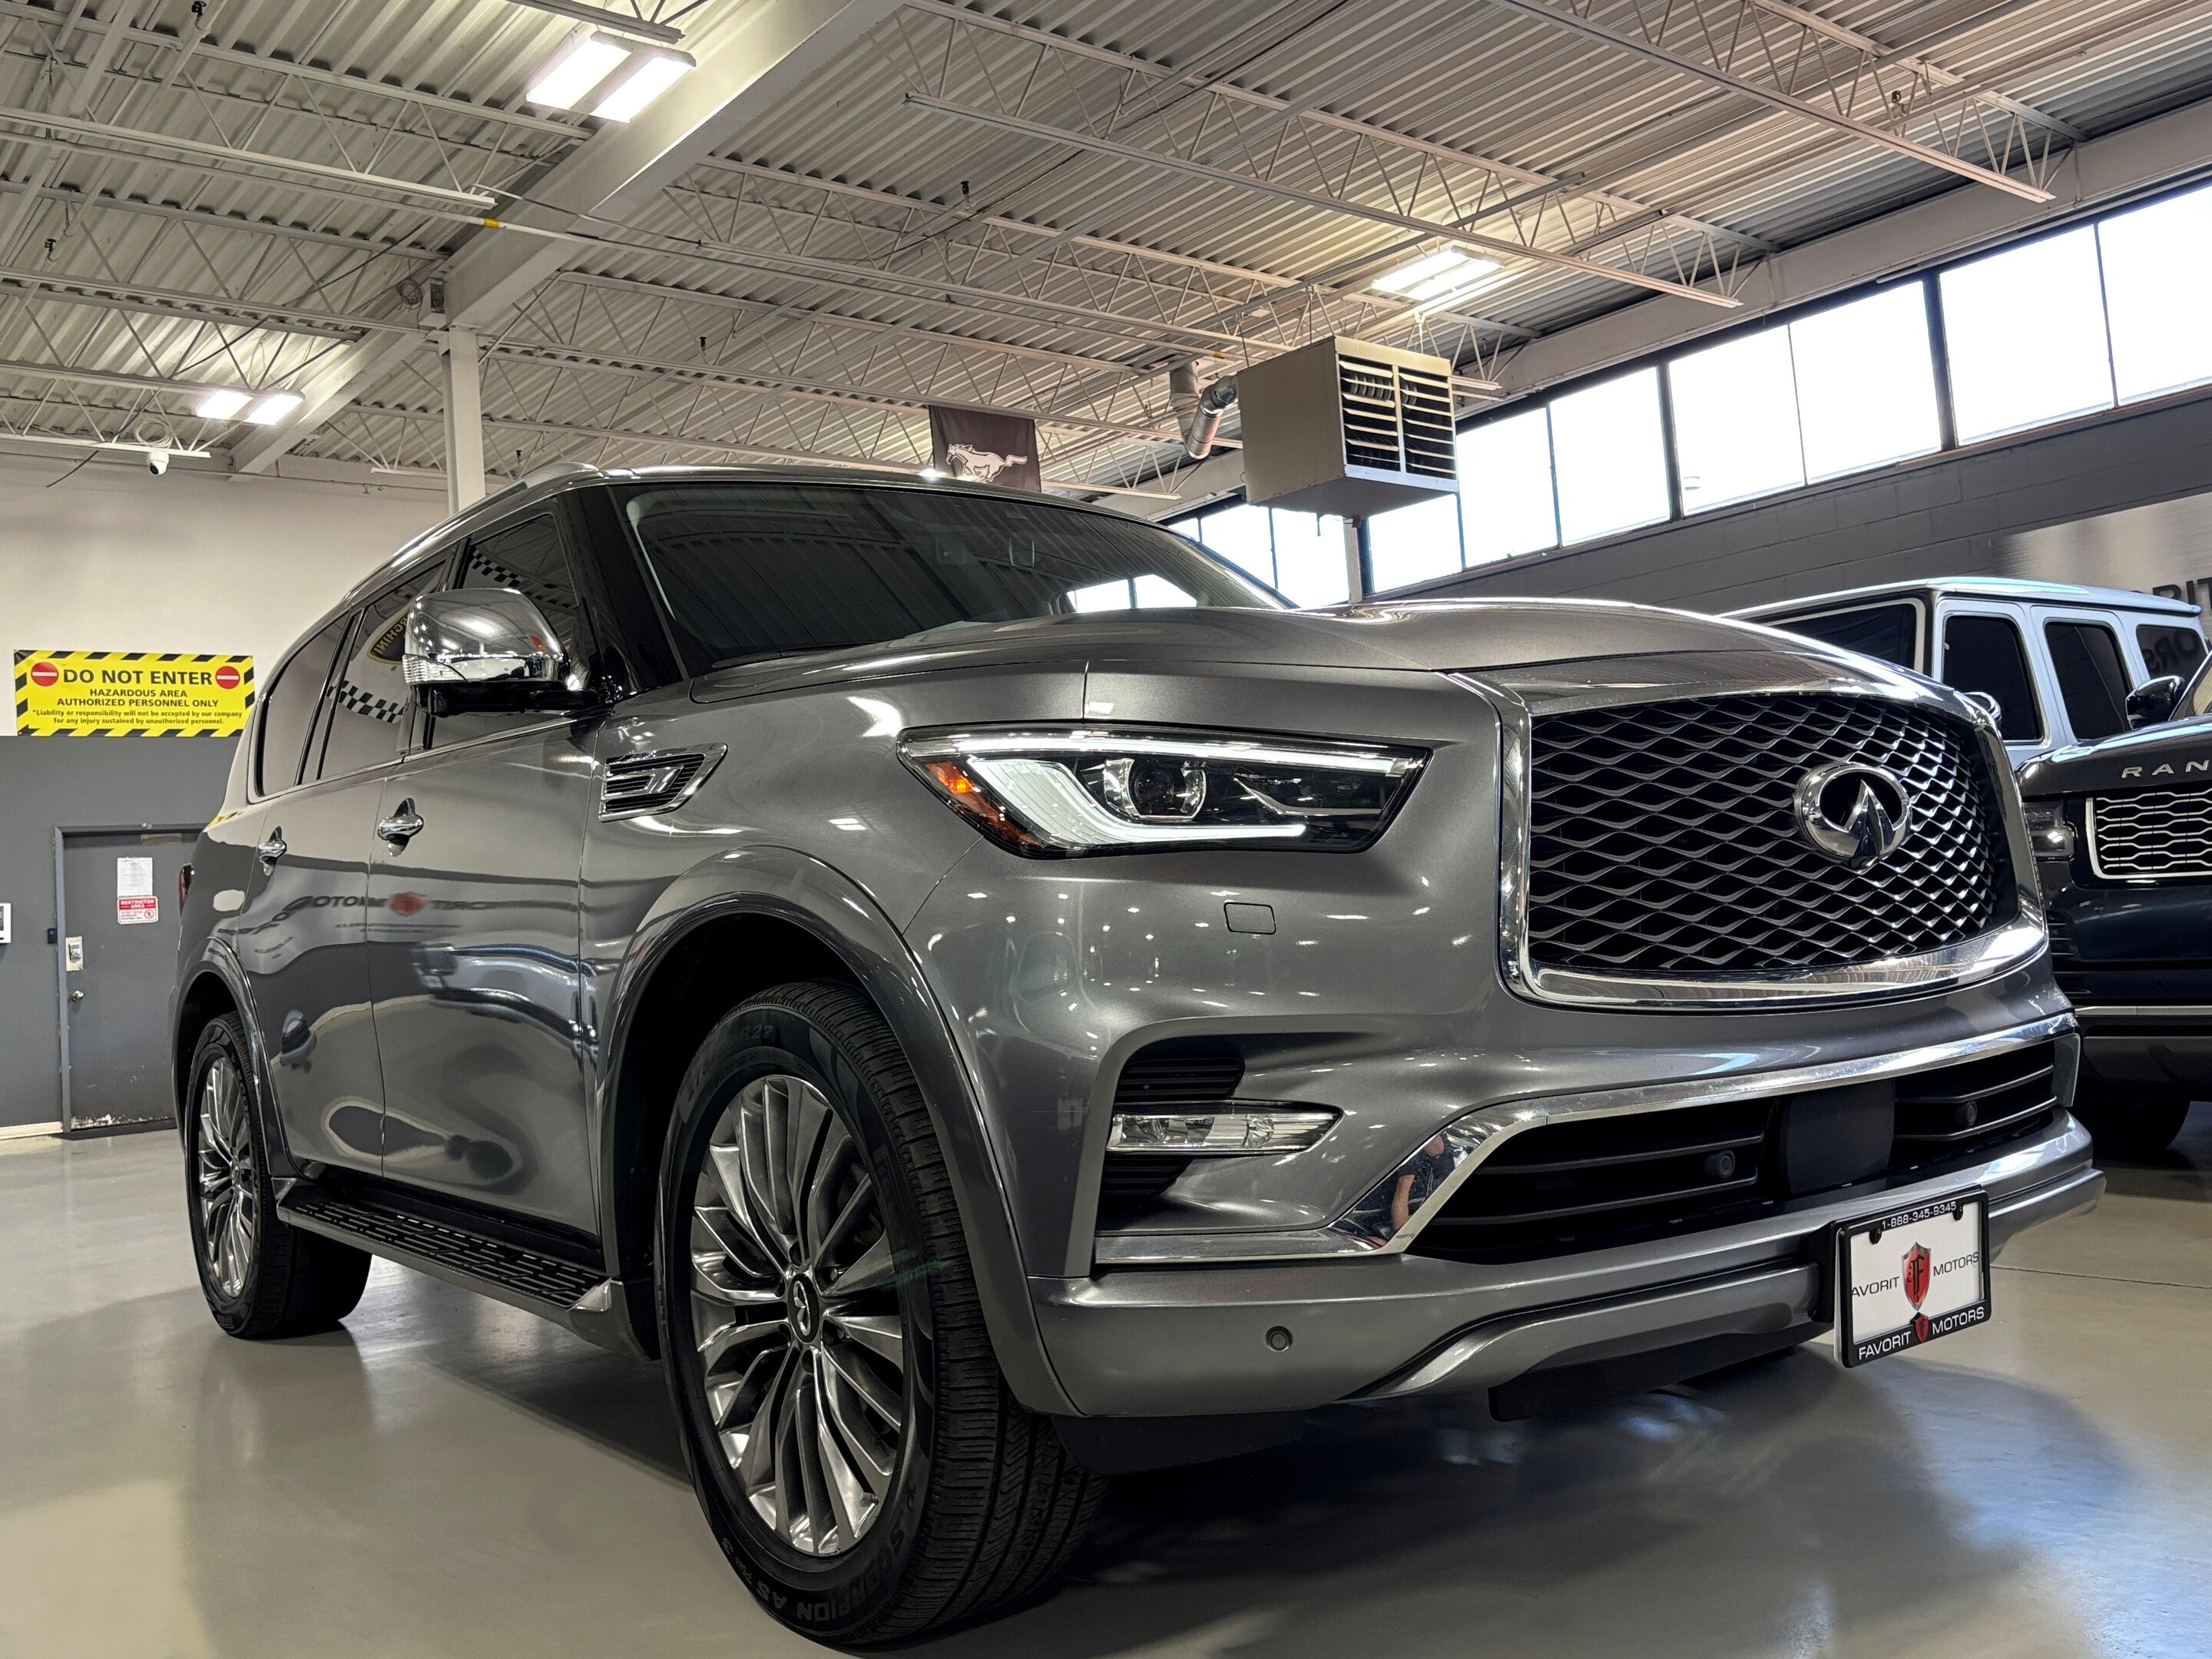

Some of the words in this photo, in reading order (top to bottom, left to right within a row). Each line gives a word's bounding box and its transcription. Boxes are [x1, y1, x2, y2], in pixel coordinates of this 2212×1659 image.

[63, 669, 94, 684] DO
[101, 670, 144, 684] NOT
[151, 671, 213, 686] ENTER
[57, 697, 125, 707] AUTHORIZED
[129, 698, 190, 707] PERSONNEL
[192, 699, 219, 707] ONLY
[90, 688, 156, 697] HAZARDOUS
[2121, 759, 2210, 779] RAN
[1881, 1200, 1957, 1230] 1-888-345-9345
[1932, 1251, 1979, 1277] MOTORS
[1858, 1331, 1912, 1361] FAVORIT
[1932, 1306, 1985, 1336] MOTORS
